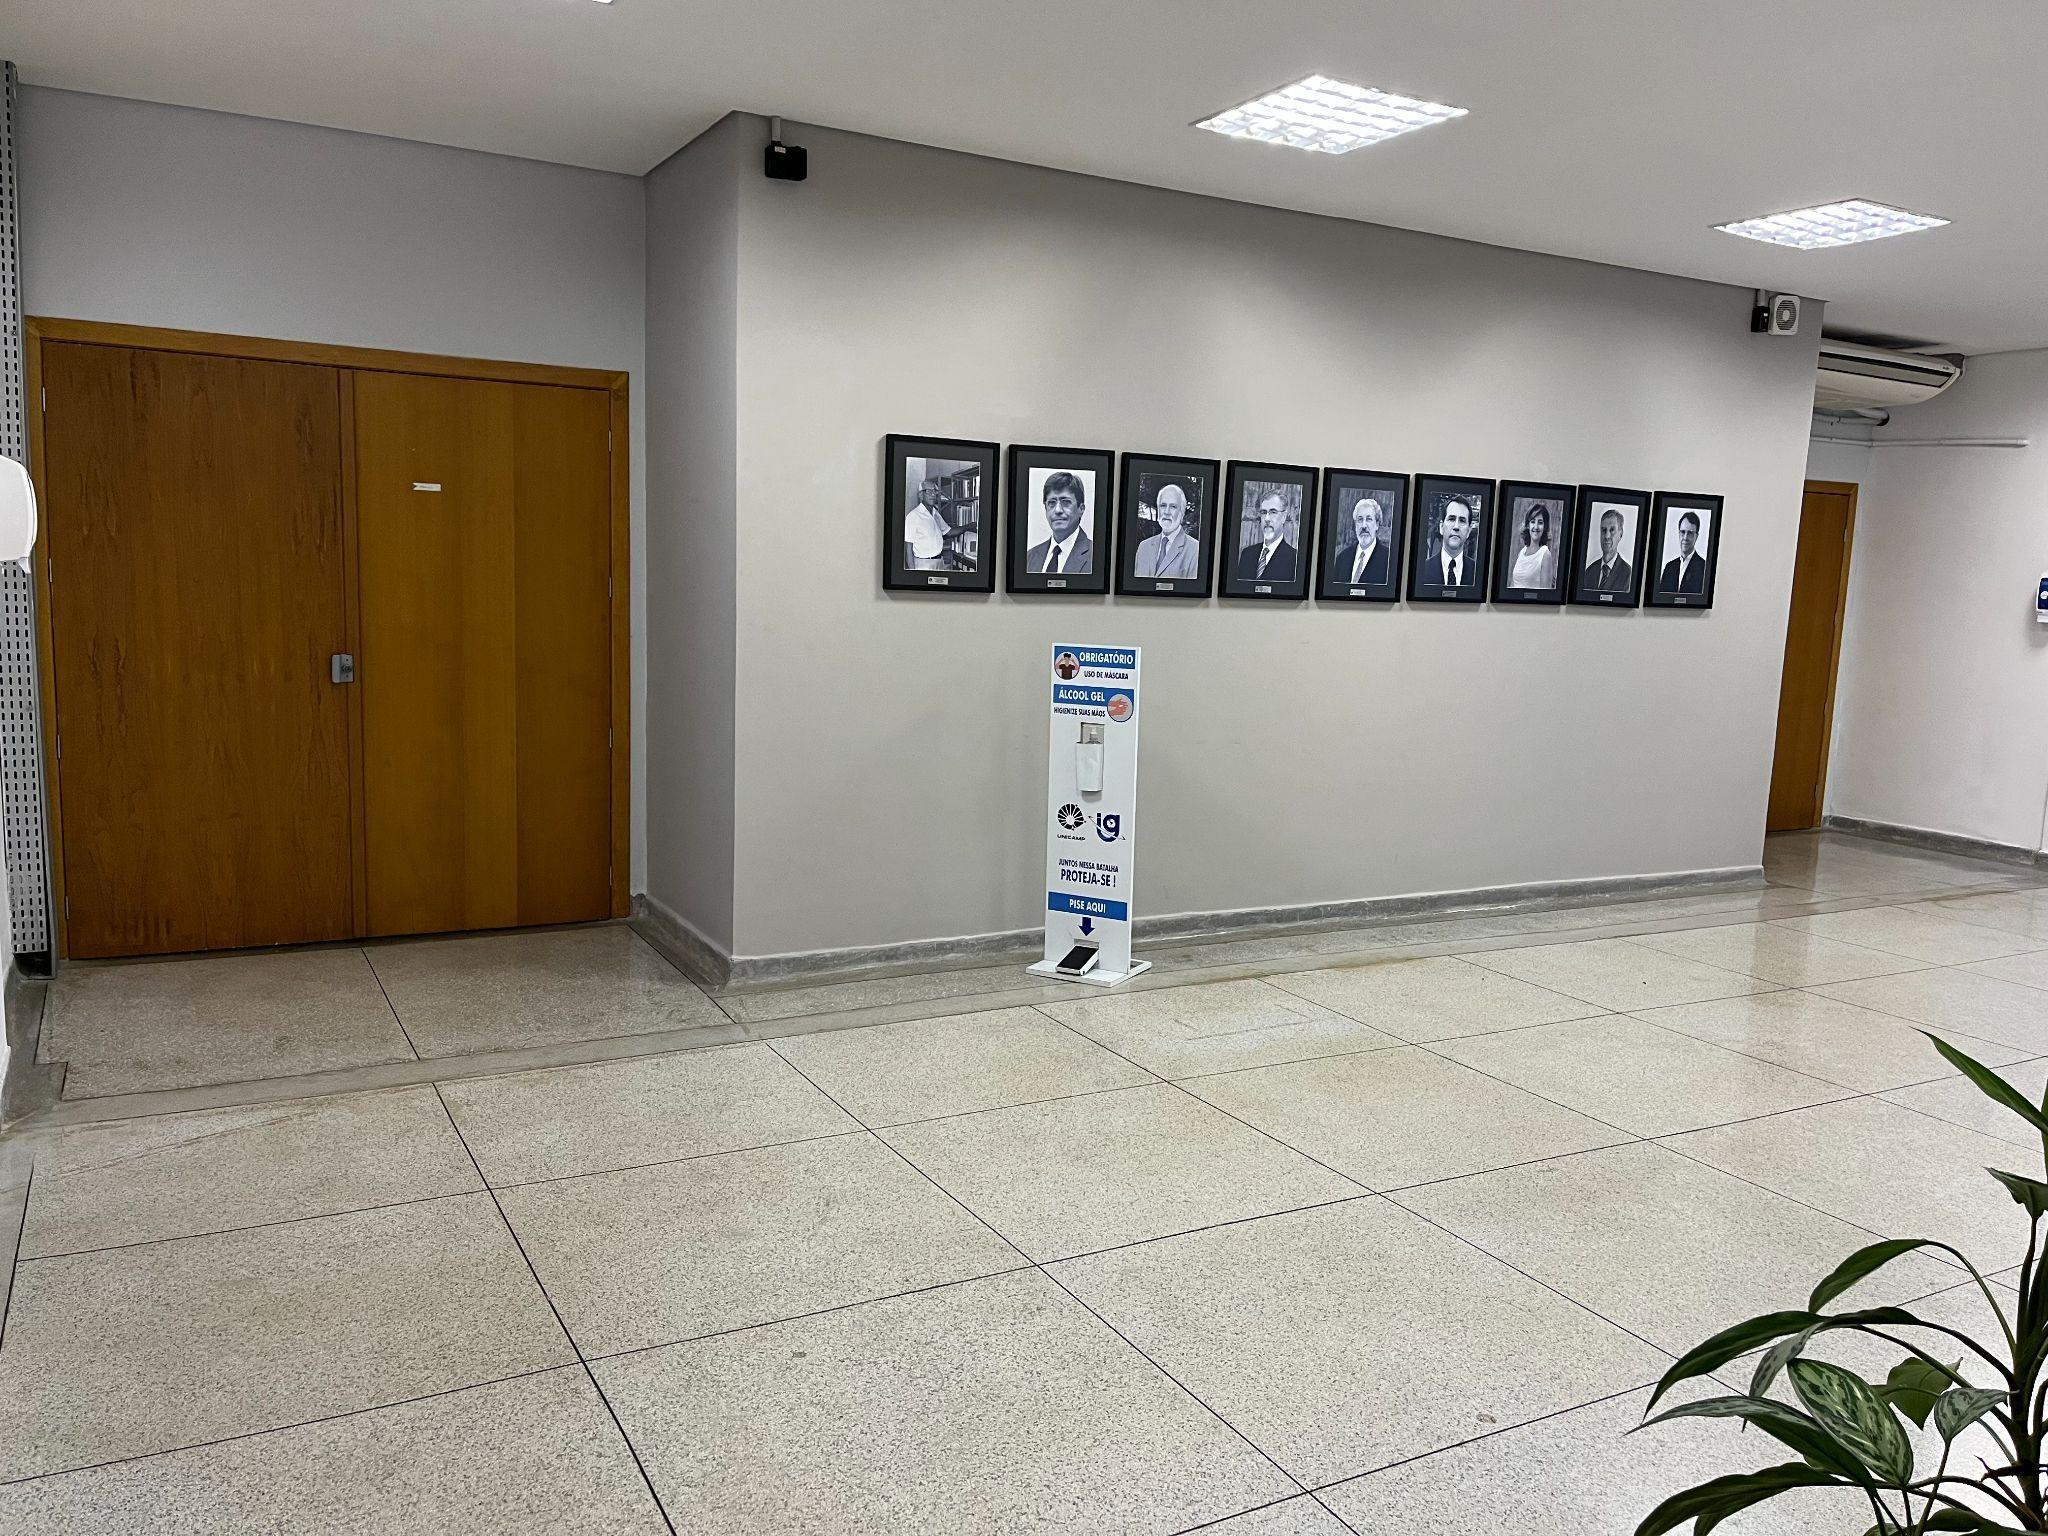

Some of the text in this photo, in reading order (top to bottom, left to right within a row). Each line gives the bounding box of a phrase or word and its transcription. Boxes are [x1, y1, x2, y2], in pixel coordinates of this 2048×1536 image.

[1079, 651, 1133, 665] OBRIGATÓRIO
[1084, 669, 1129, 680] USO DE MÁSCARA
[1058, 687, 1105, 702] ÁLCOOL GEL
[1053, 707, 1078, 716] HIGIENIZE
[1057, 833, 1086, 841] UNICAMP
[1058, 858, 1119, 873] JUNTOS NESSA BATALHA
[1060, 869, 1111, 887] PROTEJA-SE
[1069, 898, 1106, 913] PISE AQUI
